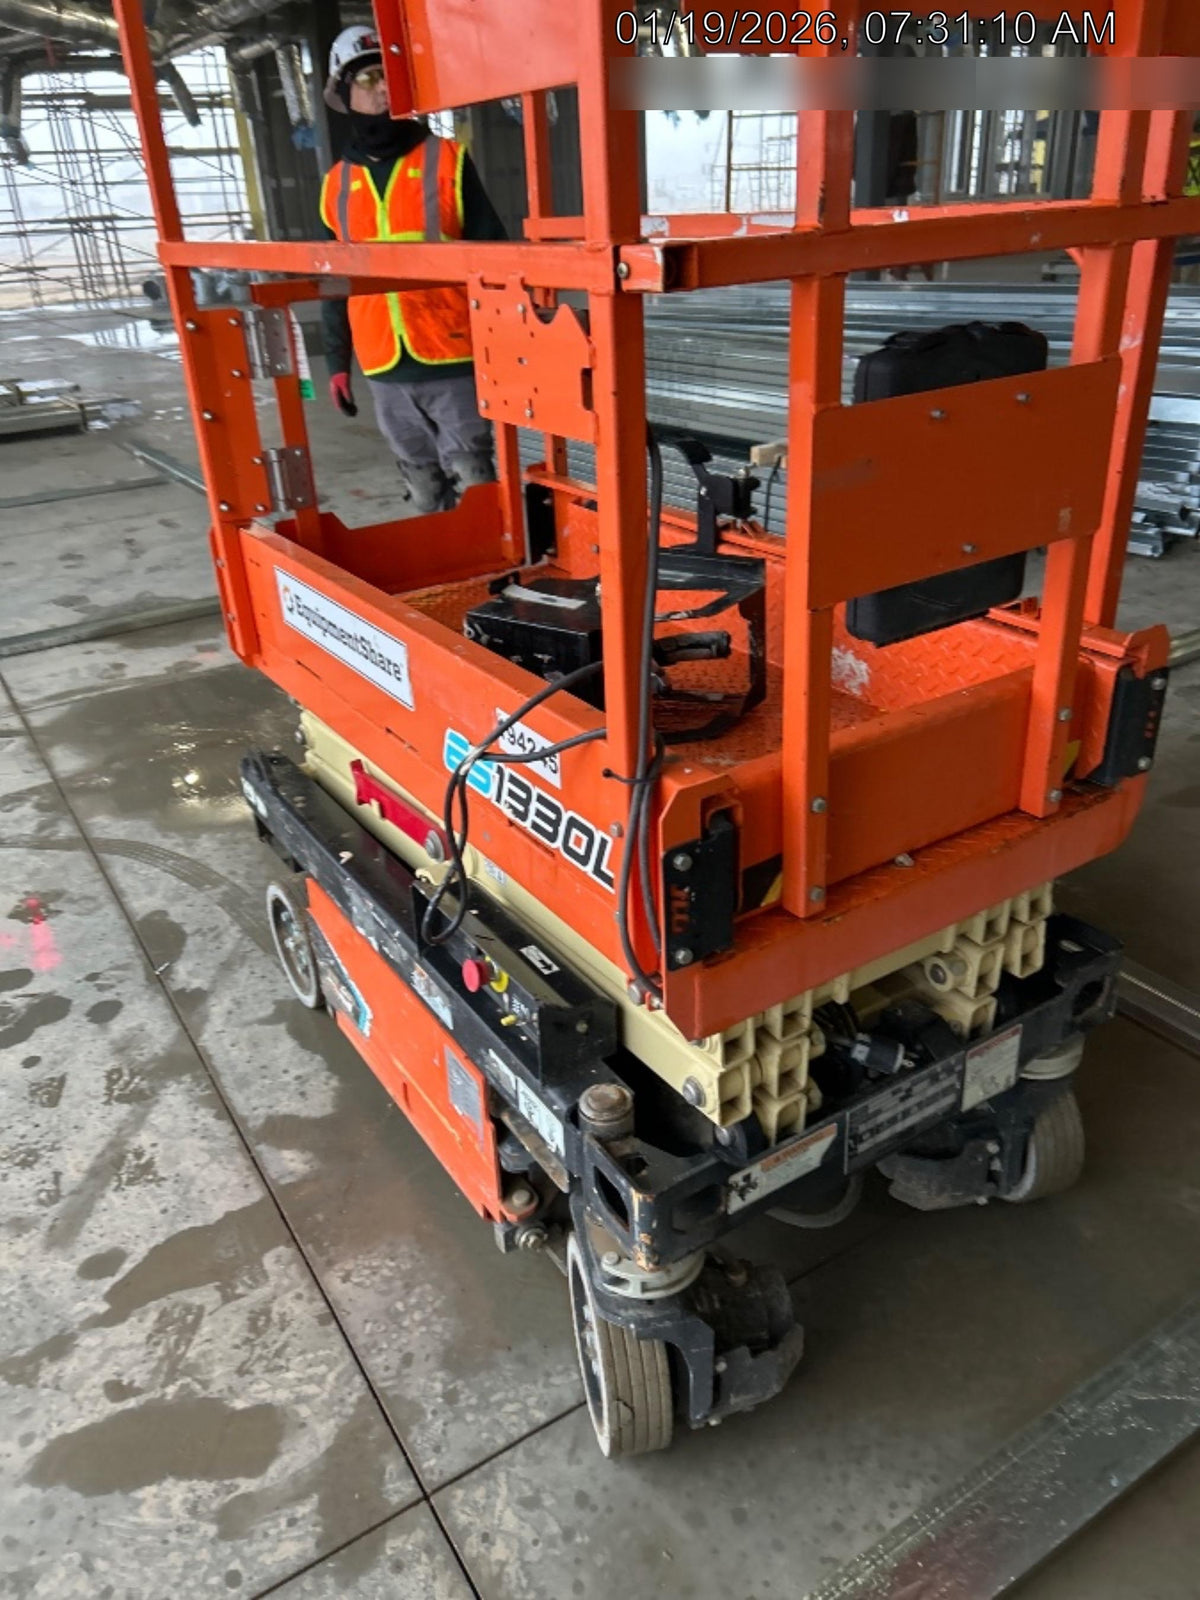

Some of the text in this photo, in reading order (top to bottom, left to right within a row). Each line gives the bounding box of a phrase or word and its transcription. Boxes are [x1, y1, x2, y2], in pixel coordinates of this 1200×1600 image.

[294, 593, 403, 682] EquipmentShare
[498, 718, 559, 775] 9425
[446, 729, 615, 889] ES1330L
